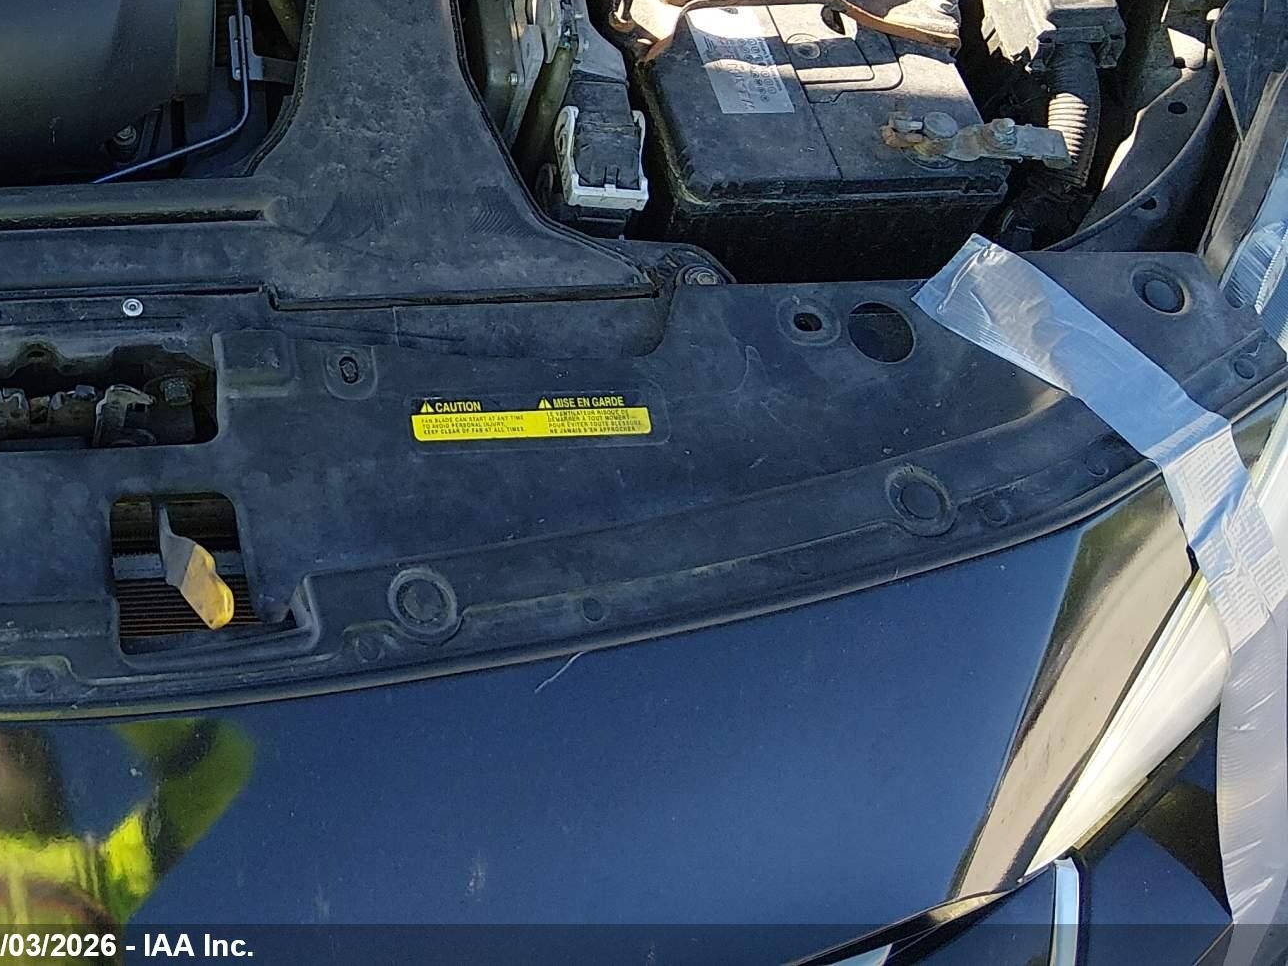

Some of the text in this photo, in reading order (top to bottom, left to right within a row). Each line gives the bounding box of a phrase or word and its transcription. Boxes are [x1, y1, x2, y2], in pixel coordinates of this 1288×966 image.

[435, 401, 481, 412] CAUTION
[553, 396, 624, 408] MISE EN GARDE
